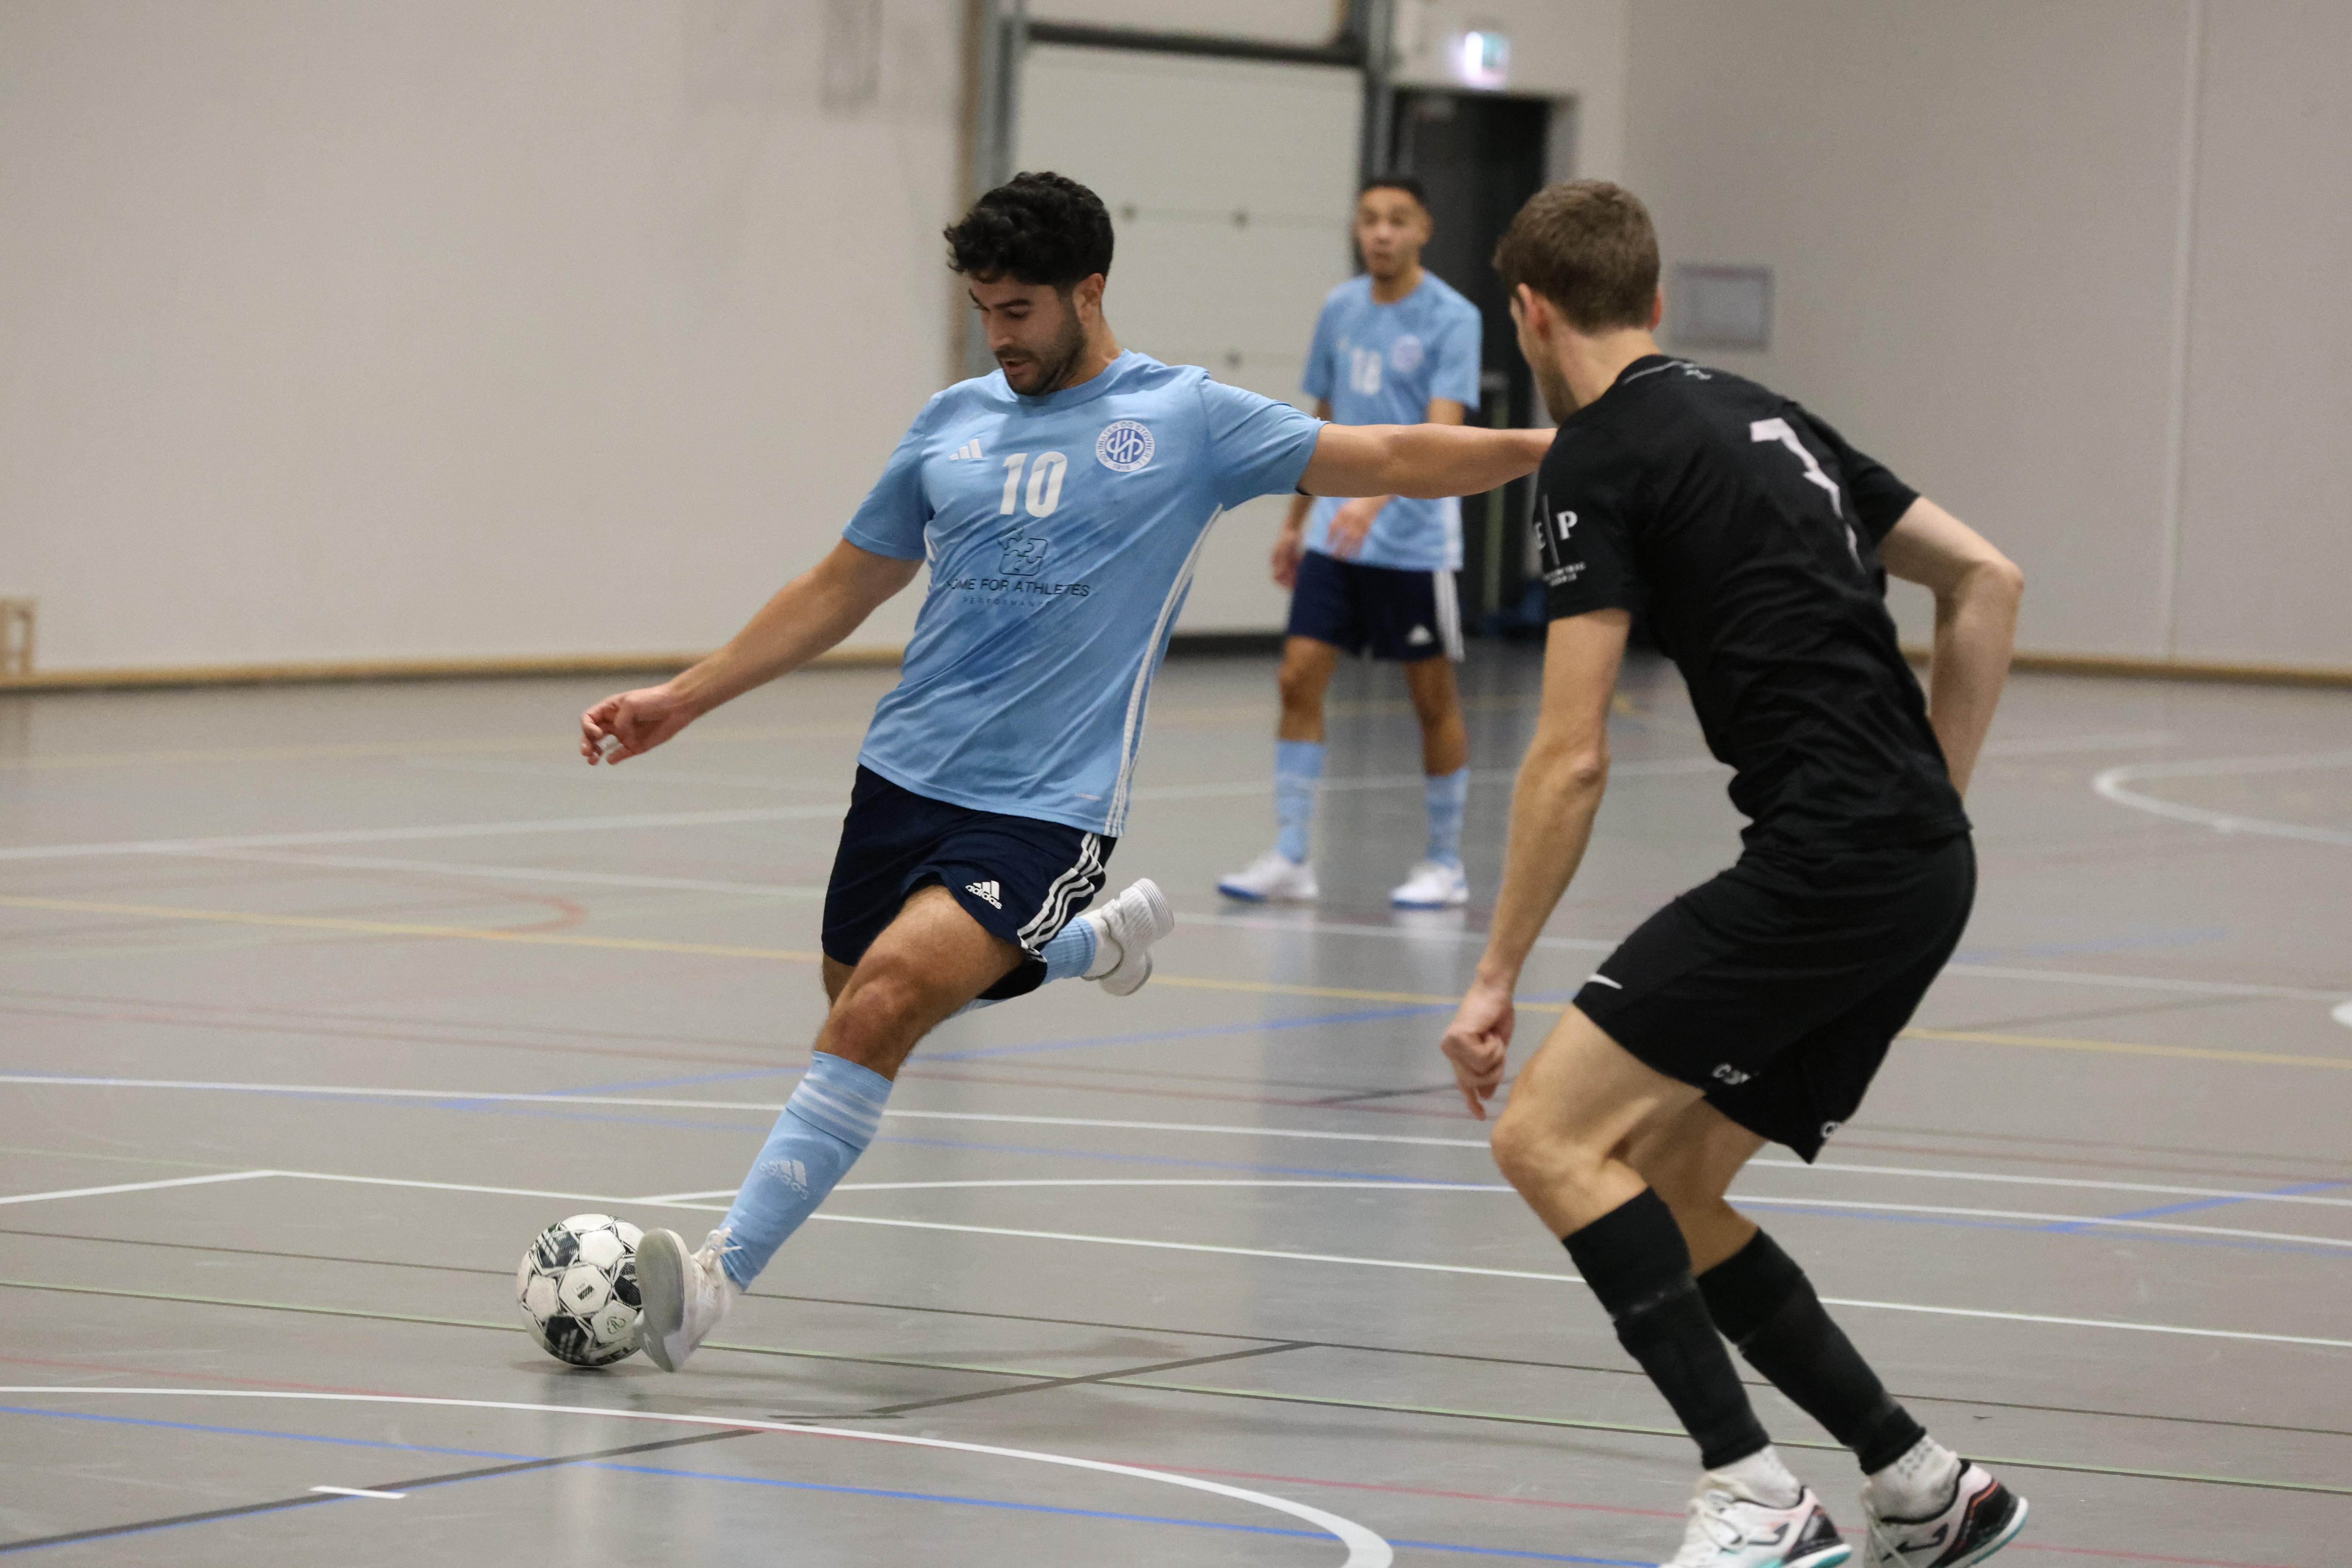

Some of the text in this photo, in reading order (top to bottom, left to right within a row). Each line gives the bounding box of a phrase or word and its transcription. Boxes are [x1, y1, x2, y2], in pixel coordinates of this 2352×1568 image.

[999, 451, 1068, 518] 10
[1556, 510, 1578, 540] P
[947, 578, 1090, 597] OME FOR ATHLETES
[965, 885, 1002, 909] adidas
